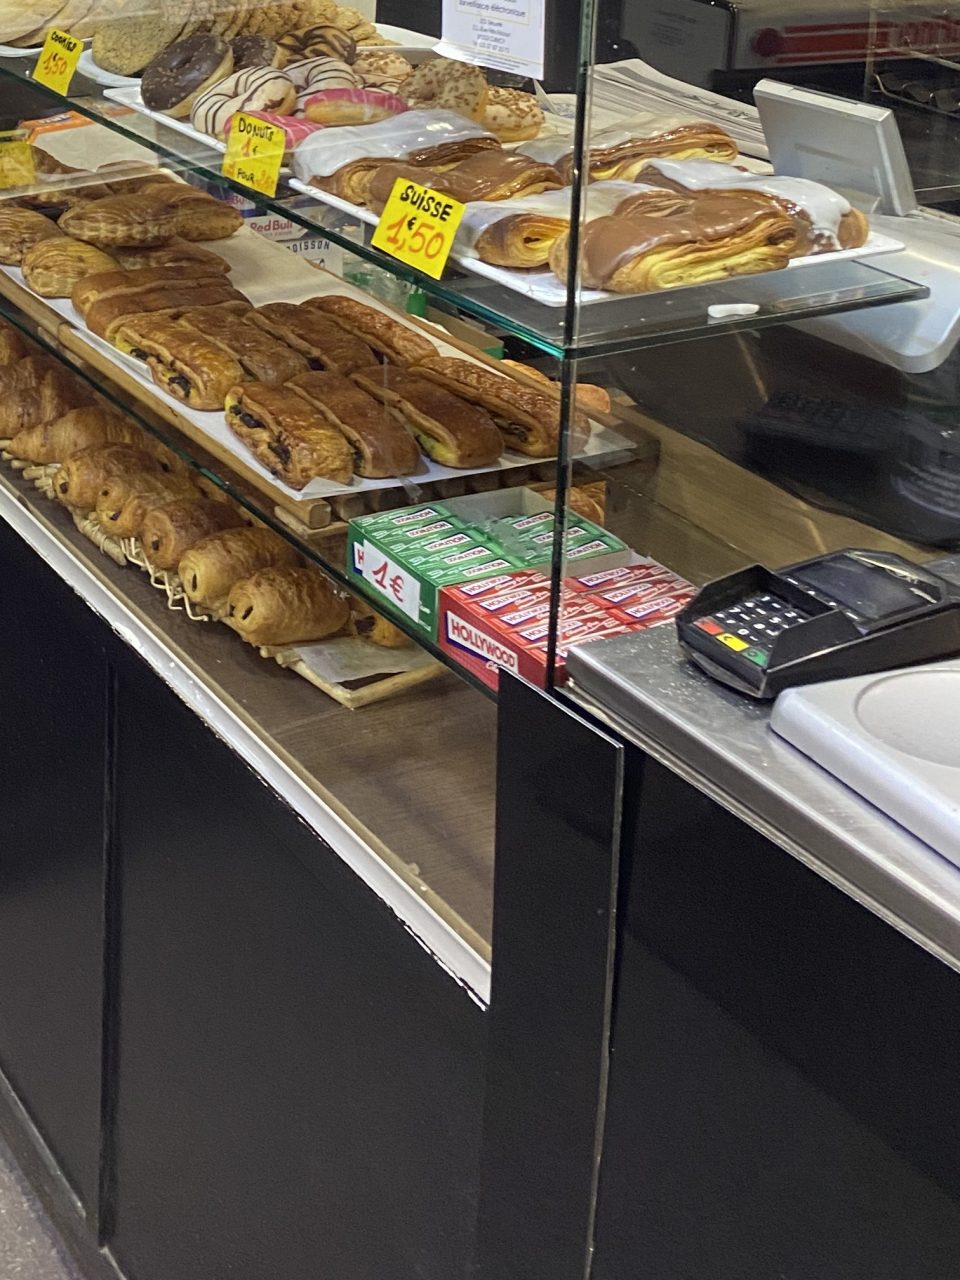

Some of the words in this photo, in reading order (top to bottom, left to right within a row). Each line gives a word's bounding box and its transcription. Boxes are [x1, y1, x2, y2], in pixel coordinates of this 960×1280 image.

[238, 117, 275, 142] DONUTS
[286, 240, 331, 254] OISSON
[451, 623, 516, 669] HOLLYWOOD
